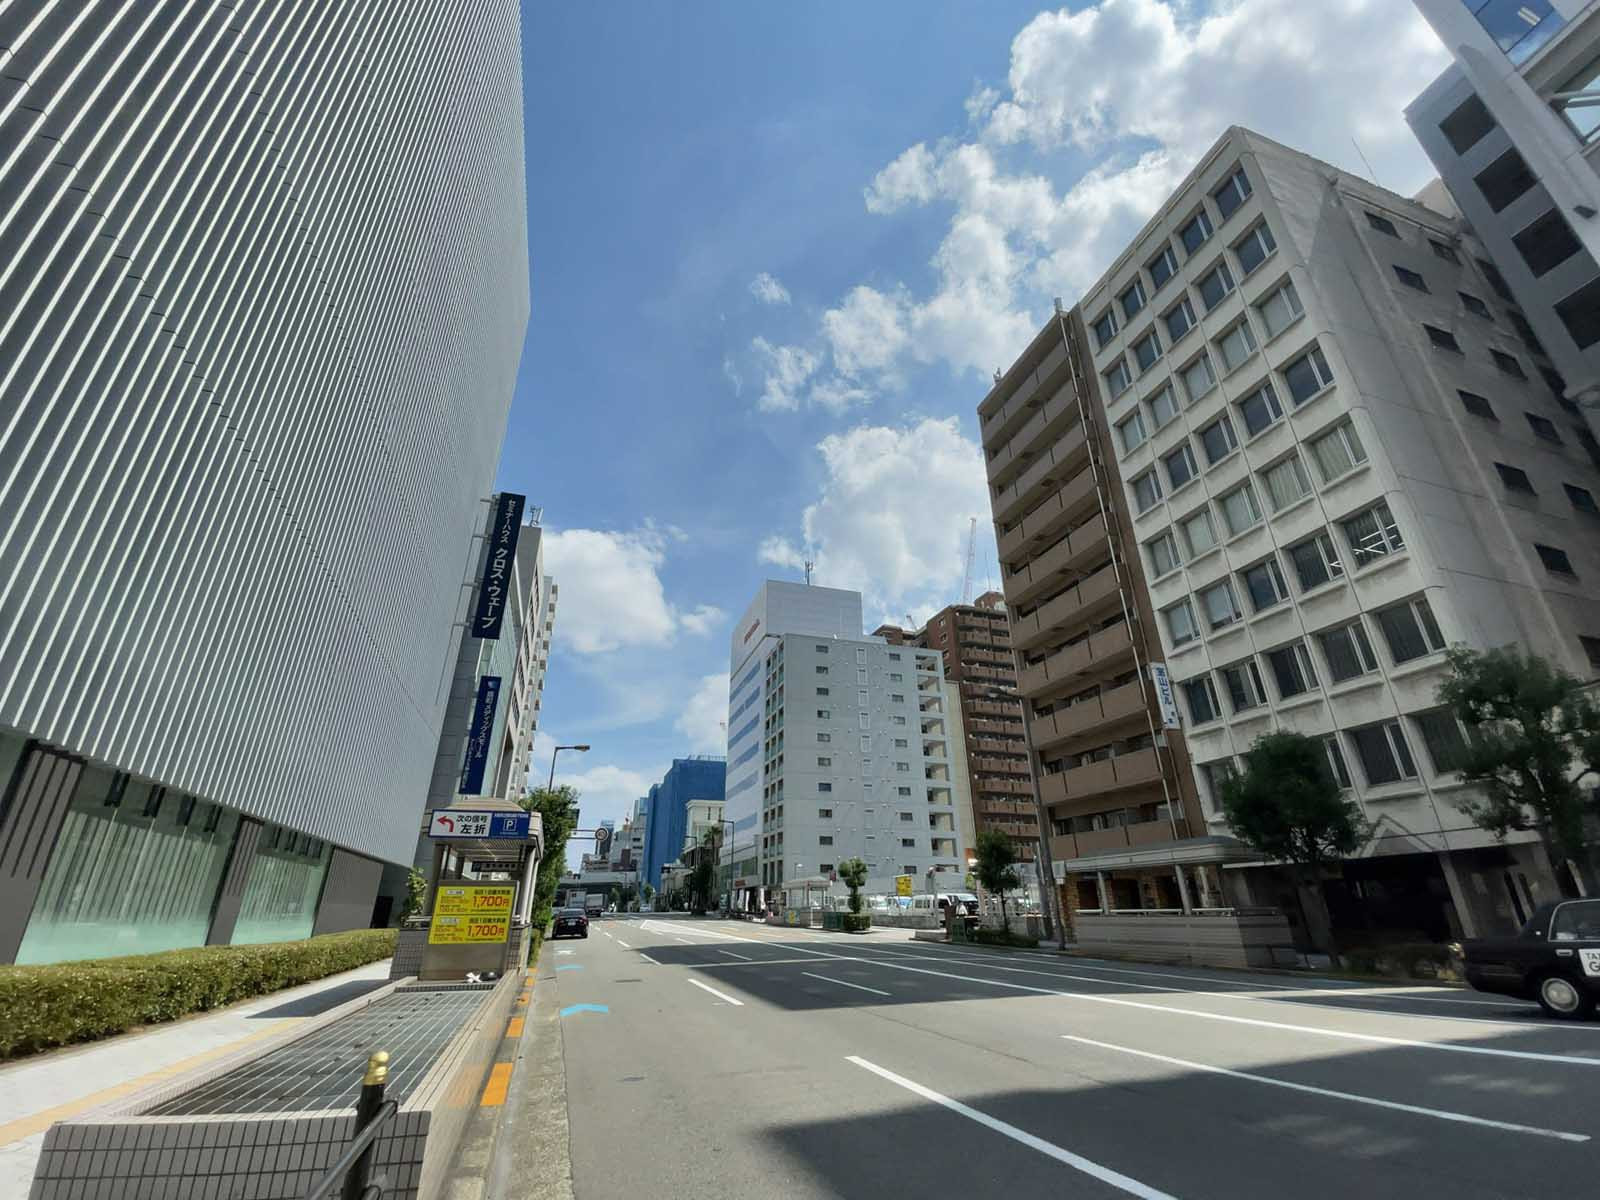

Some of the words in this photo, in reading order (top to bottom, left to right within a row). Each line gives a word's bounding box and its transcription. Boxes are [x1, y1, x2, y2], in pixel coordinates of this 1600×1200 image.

[456, 814, 488, 823] 次の信号
[460, 824, 486, 834] 左折
